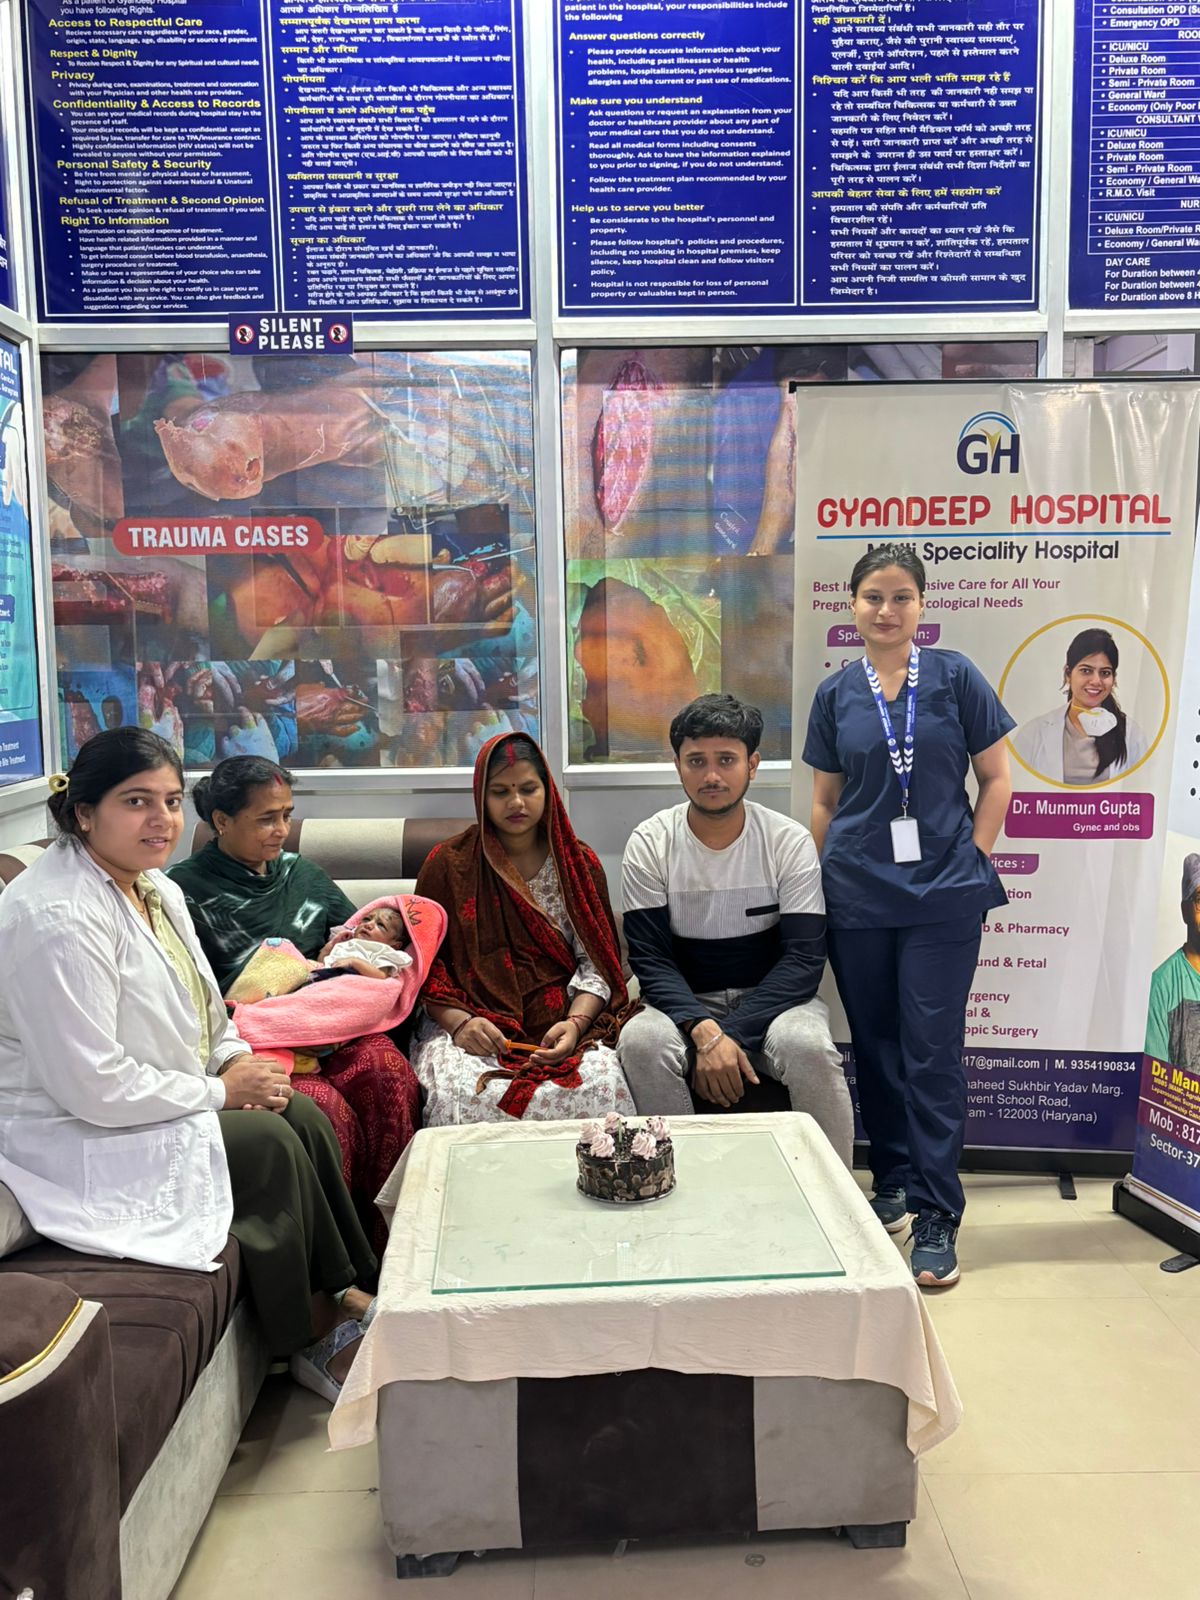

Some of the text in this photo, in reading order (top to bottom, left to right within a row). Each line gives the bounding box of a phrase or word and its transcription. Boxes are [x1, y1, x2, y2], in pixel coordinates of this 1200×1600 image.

[1110, 5, 1186, 14] Consultation OPD
[48, 18, 91, 27] Access
[109, 17, 171, 28] Respectful
[175, 17, 202, 26] Care
[1110, 18, 1180, 28] Emergency OPD
[569, 31, 704, 40] Answer questions correctly
[1109, 42, 1148, 50] ICU/NICU
[50, 49, 88, 58] Respect
[102, 48, 137, 58] Dignity
[1109, 54, 1166, 63] Deluxe Room
[51, 70, 94, 80] Privacy
[1109, 66, 1166, 75] Private Room
[1108, 79, 1129, 87] Semi
[1137, 78, 1167, 86] Private
[1169, 78, 1194, 86] Room
[1108, 90, 1167, 99] General Ward
[53, 99, 136, 109] Confidentiality
[152, 99, 194, 107] Access
[197, 99, 209, 107] to
[212, 98, 260, 107] Records
[570, 97, 597, 105] Make
[645, 95, 702, 103] understand
[1108, 101, 1196, 112] Economy (Only Poor
[1136, 115, 1195, 123] CONSULTANT
[1107, 129, 1146, 137] ICU/NICU
[1107, 141, 1163, 149] Deluxe Room
[1107, 152, 1163, 161] Private Room
[57, 160, 108, 168] Personal
[112, 159, 147, 170] Safety
[163, 159, 211, 170] Security
[1106, 188, 1154, 197] R.M.O. Visit
[59, 196, 98, 204] Refusal
[102, 196, 112, 204] of
[115, 196, 167, 204] Treatment
[181, 196, 220, 204] Second
[223, 195, 264, 205] Opinion
[571, 204, 594, 212] Help
[61, 216, 168, 226] Right To Information
[1105, 213, 1144, 221] ICU/NICU
[1105, 225, 1192, 234] Deluxe Room/Private
[1105, 257, 1150, 266] DAY CARE
[1121, 293, 1156, 301] Duration
[1159, 292, 1184, 300] above
[260, 318, 322, 332] SILENT
[258, 334, 324, 349] PLEASE
[817, 494, 1170, 527] GYANDEEP HOSPITAL
[128, 525, 308, 547] TRAUMA CASES
[922, 540, 1027, 565] Speciality
[1035, 539, 1118, 563] Hospital
[813, 582, 839, 592] Best
[958, 579, 986, 589] Care
[990, 578, 1008, 589] for
[1011, 577, 1028, 588] All
[1032, 578, 1060, 588] Your
[813, 597, 1023, 612] Pregna cological Needs
[1012, 800, 1139, 818] Dr. Munmun Gupta
[1073, 822, 1139, 833] Gynec and obs
[1008, 923, 1069, 936] Pharmacy
[1017, 958, 1046, 967] Fetal
[970, 992, 1010, 1004] rgency
[992, 1025, 1038, 1038] Surgery
[962, 1056, 1135, 1071] 17@gmail.com M. 9354190834
[1152, 1061, 1168, 1080] Dr.
[1172, 1069, 1200, 1094] Man
[1008, 1080, 1050, 1091] Sukhbir
[1054, 1081, 1088, 1093] Yadav
[1092, 1083, 1122, 1097] Marg.
[968, 1094, 1070, 1107] vent School Road,
[998, 1108, 1037, 1119] 122003
[1041, 1110, 1096, 1123] (Haryana)
[1149, 1108, 1173, 1132] Mob
